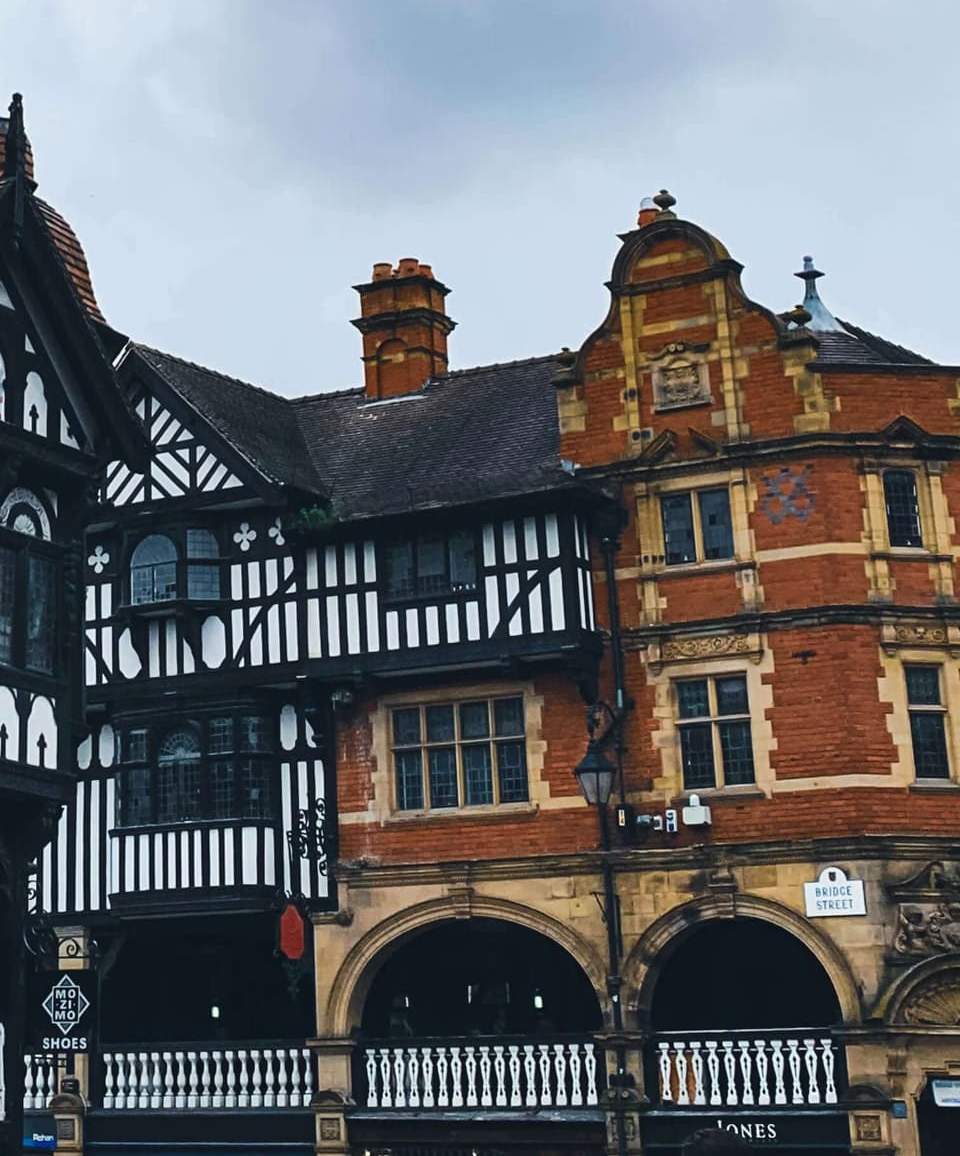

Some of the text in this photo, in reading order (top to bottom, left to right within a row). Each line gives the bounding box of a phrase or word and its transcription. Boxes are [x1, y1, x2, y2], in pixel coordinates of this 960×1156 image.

[815, 886, 853, 897] BRIDGE
[816, 899, 853, 910] STREET
[55, 989, 76, 999] MO
[55, 1011, 76, 1020] MO
[42, 1037, 87, 1050] SHOES
